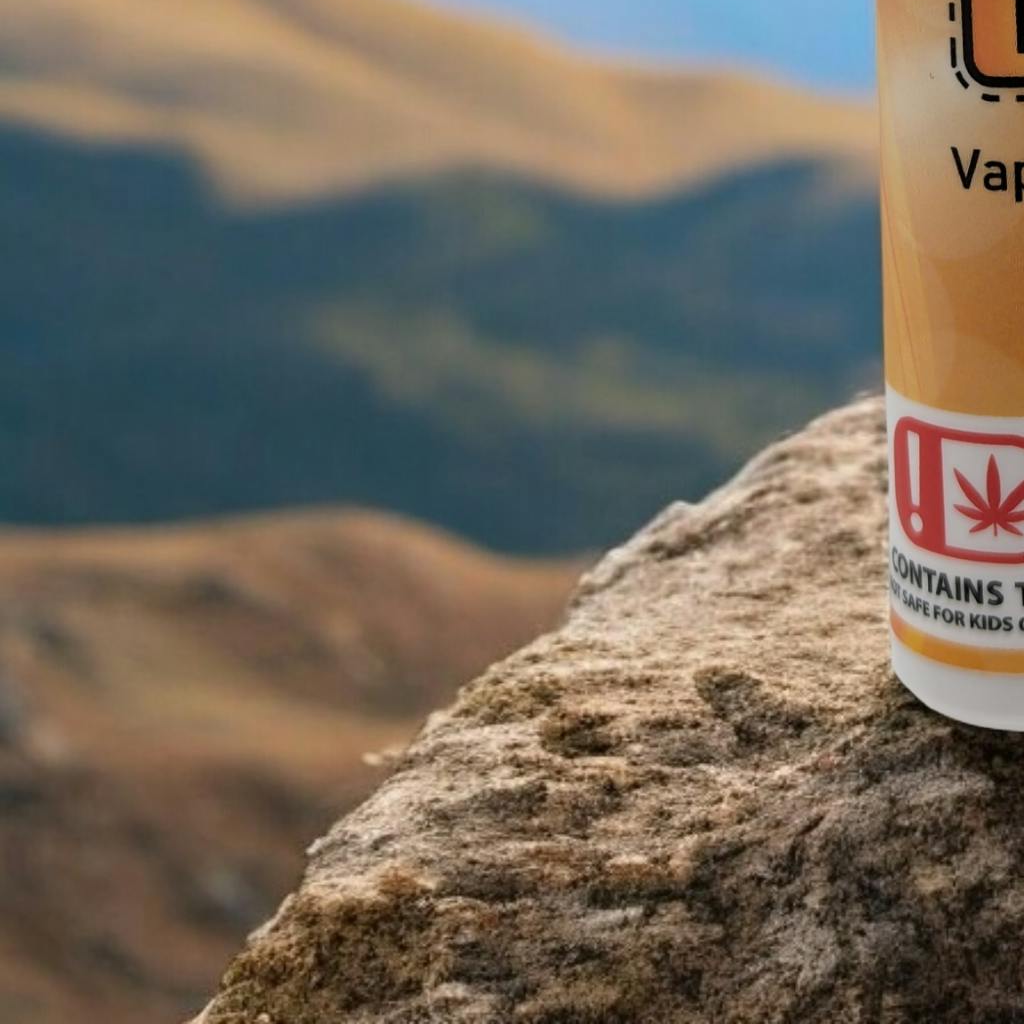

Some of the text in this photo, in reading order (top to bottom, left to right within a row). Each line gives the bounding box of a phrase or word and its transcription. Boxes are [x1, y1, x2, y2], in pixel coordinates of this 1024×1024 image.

[891, 546, 1005, 606] CONTAINS
[902, 589, 930, 617] SAFE
[933, 604, 966, 628] FOR
[969, 613, 1014, 632] KIDS
